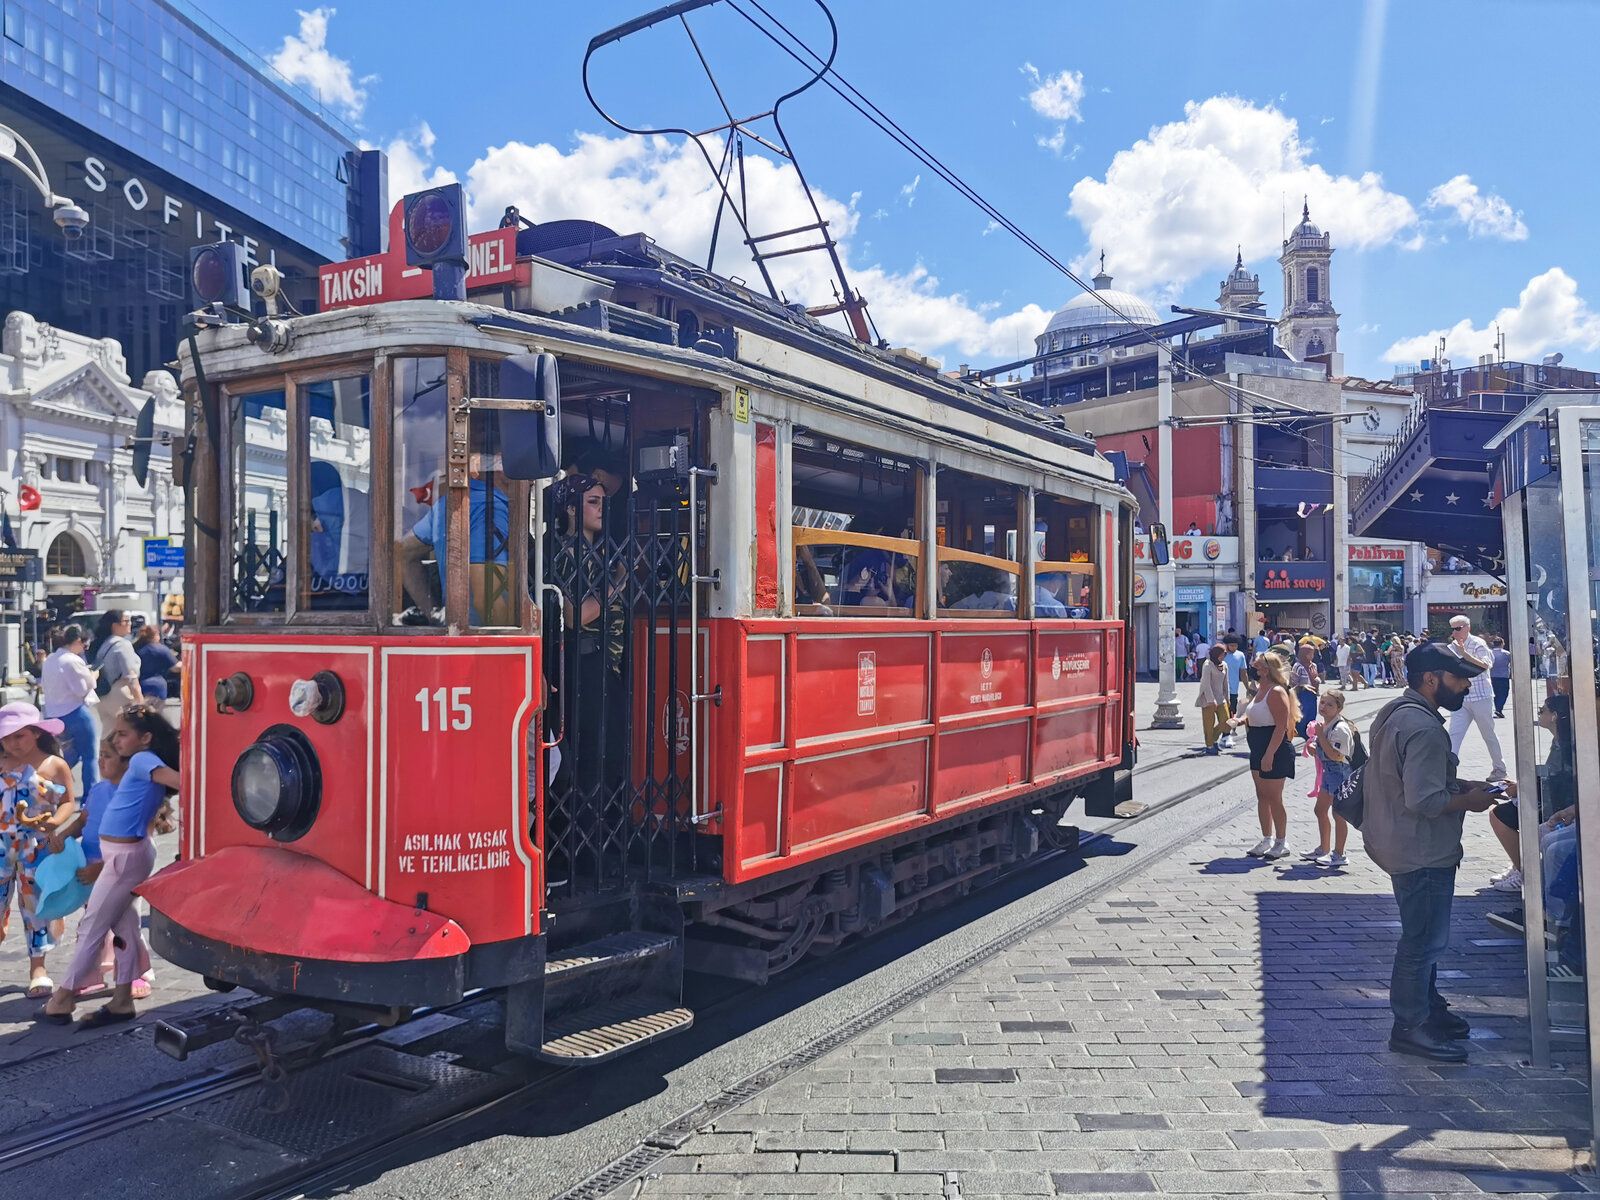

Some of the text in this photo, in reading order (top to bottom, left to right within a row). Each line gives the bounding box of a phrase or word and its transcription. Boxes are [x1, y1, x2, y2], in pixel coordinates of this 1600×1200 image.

[84, 156, 286, 279] SOFITEL
[321, 259, 383, 305] TAKSİM
[1348, 545, 1405, 560] Pehlivan
[1264, 569, 1291, 589] simit
[415, 686, 473, 732] 115
[404, 828, 508, 852] ASILMAK YASAK
[398, 849, 511, 874] VE TEHLİKELİDİR
